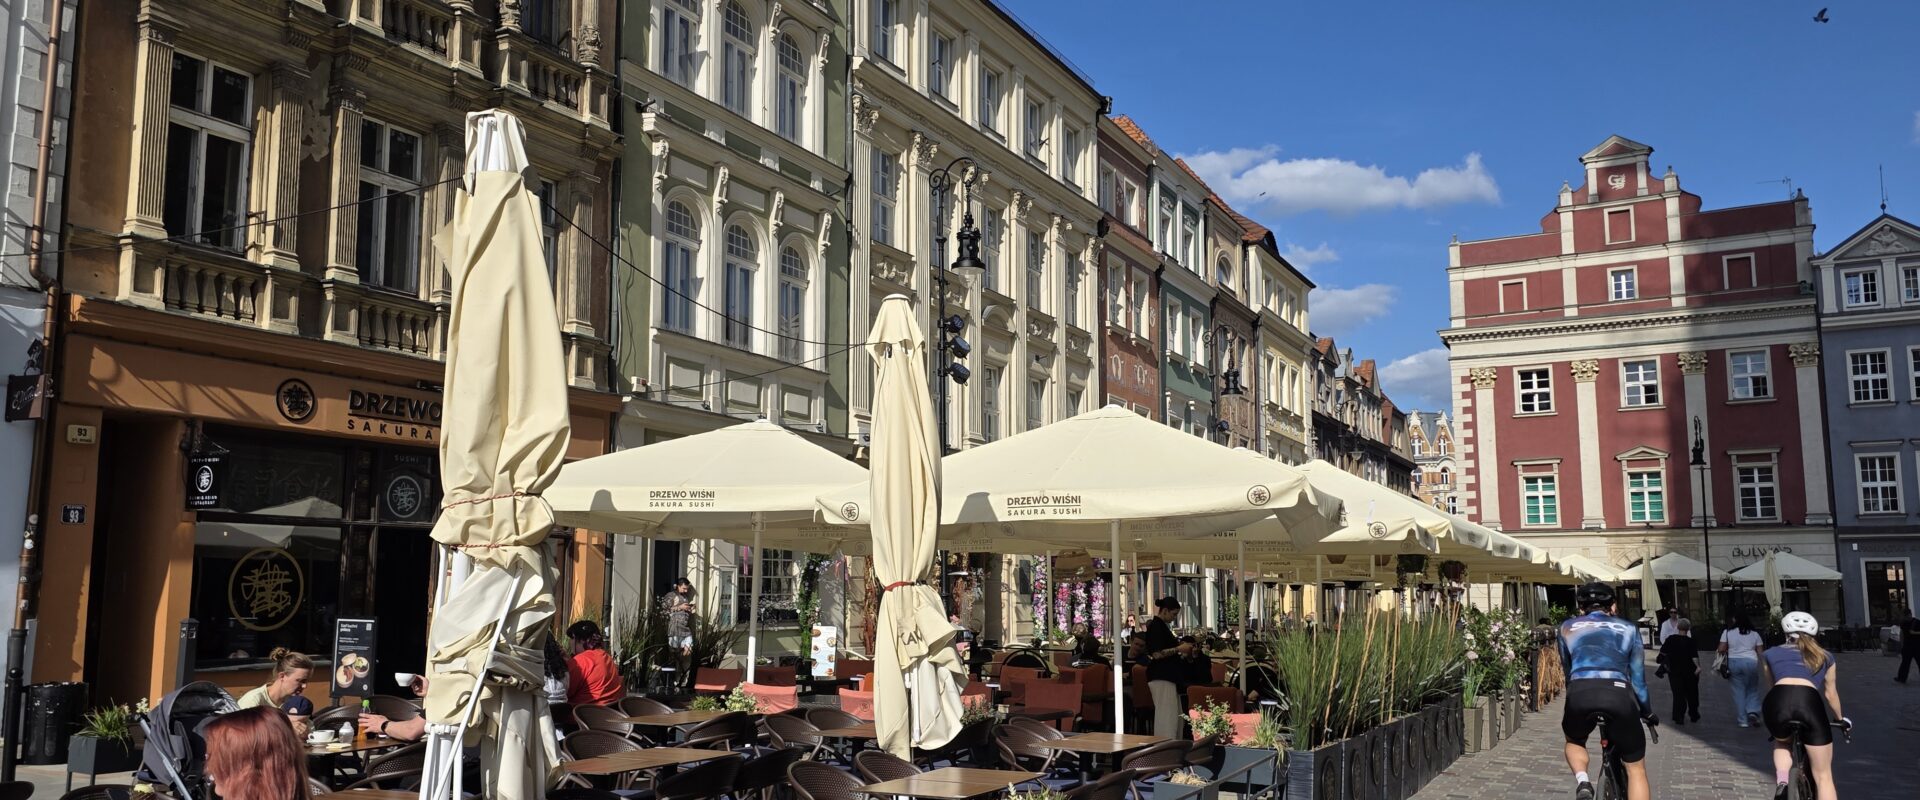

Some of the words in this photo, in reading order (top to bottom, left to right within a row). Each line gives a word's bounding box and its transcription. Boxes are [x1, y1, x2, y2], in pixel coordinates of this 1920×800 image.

[349, 389, 443, 421] DRZEWO
[77, 427, 87, 437] 93
[347, 419, 433, 440] SAKURA
[394, 454, 420, 463] SUSHI
[649, 490, 687, 499] DRZEWO
[689, 488, 715, 499] WIŚNI
[1007, 495, 1050, 506] DRZEWO
[1051, 493, 1082, 505] WIŚNI
[70, 509, 79, 523] 93
[1007, 508, 1046, 517] SAKURA
[1052, 507, 1082, 515] SUSHI
